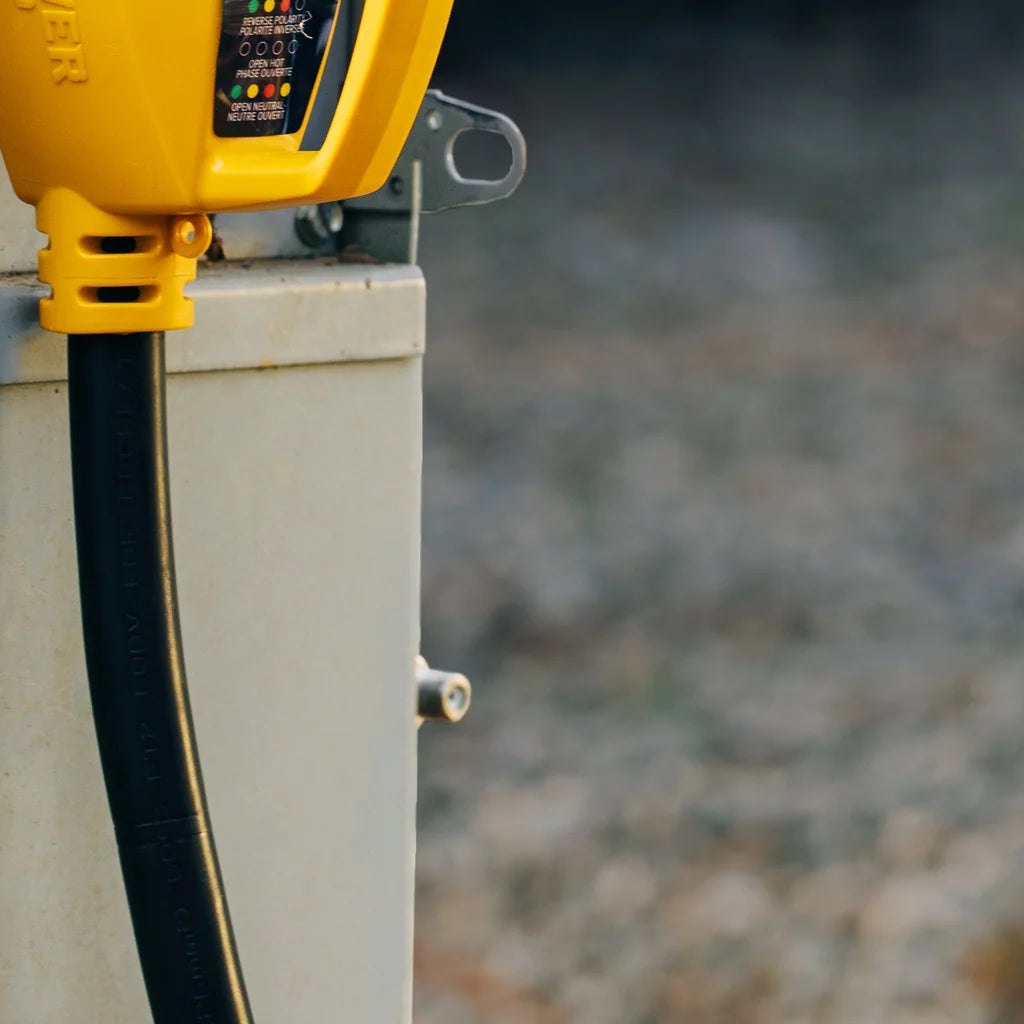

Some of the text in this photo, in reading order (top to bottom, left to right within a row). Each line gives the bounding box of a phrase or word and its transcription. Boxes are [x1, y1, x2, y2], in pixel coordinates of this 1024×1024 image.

[242, 15, 274, 26] REVERSE
[248, 58, 285, 68] OPEN HOT
[236, 67, 293, 78] PHASE OUVERTE
[231, 102, 252, 111] OPEN
[227, 110, 285, 122] NEUTRE OUVERT
